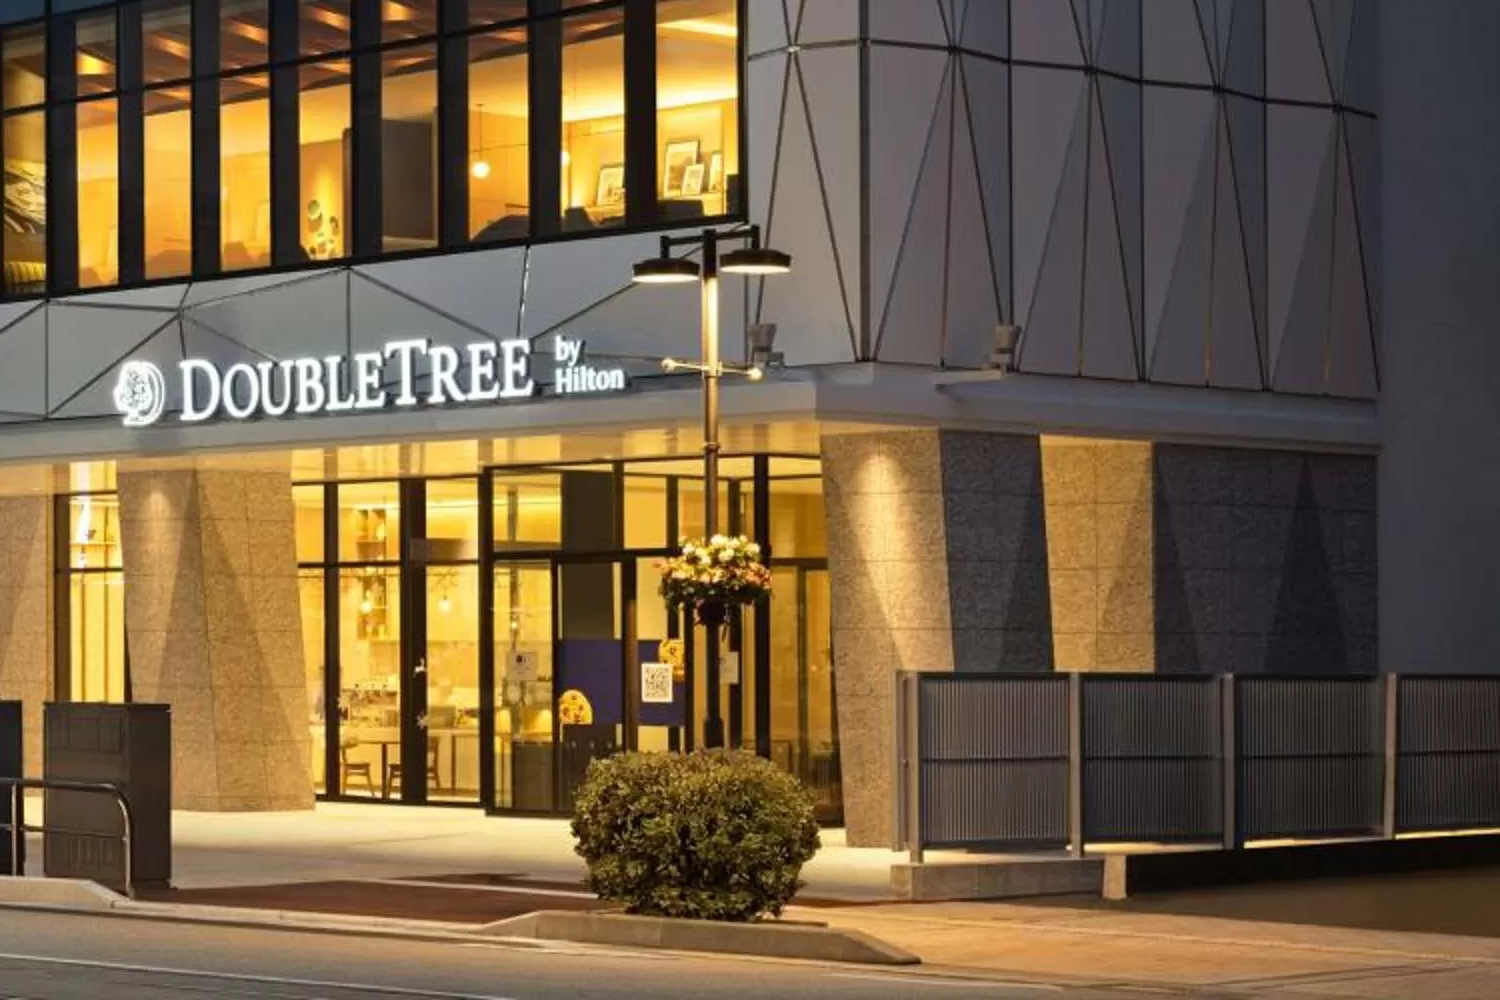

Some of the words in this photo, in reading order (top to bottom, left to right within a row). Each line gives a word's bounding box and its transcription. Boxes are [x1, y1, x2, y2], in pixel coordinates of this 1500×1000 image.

[555, 334, 581, 367] by
[178, 338, 535, 421] DOUBLETREE
[555, 365, 625, 393] Hilton
